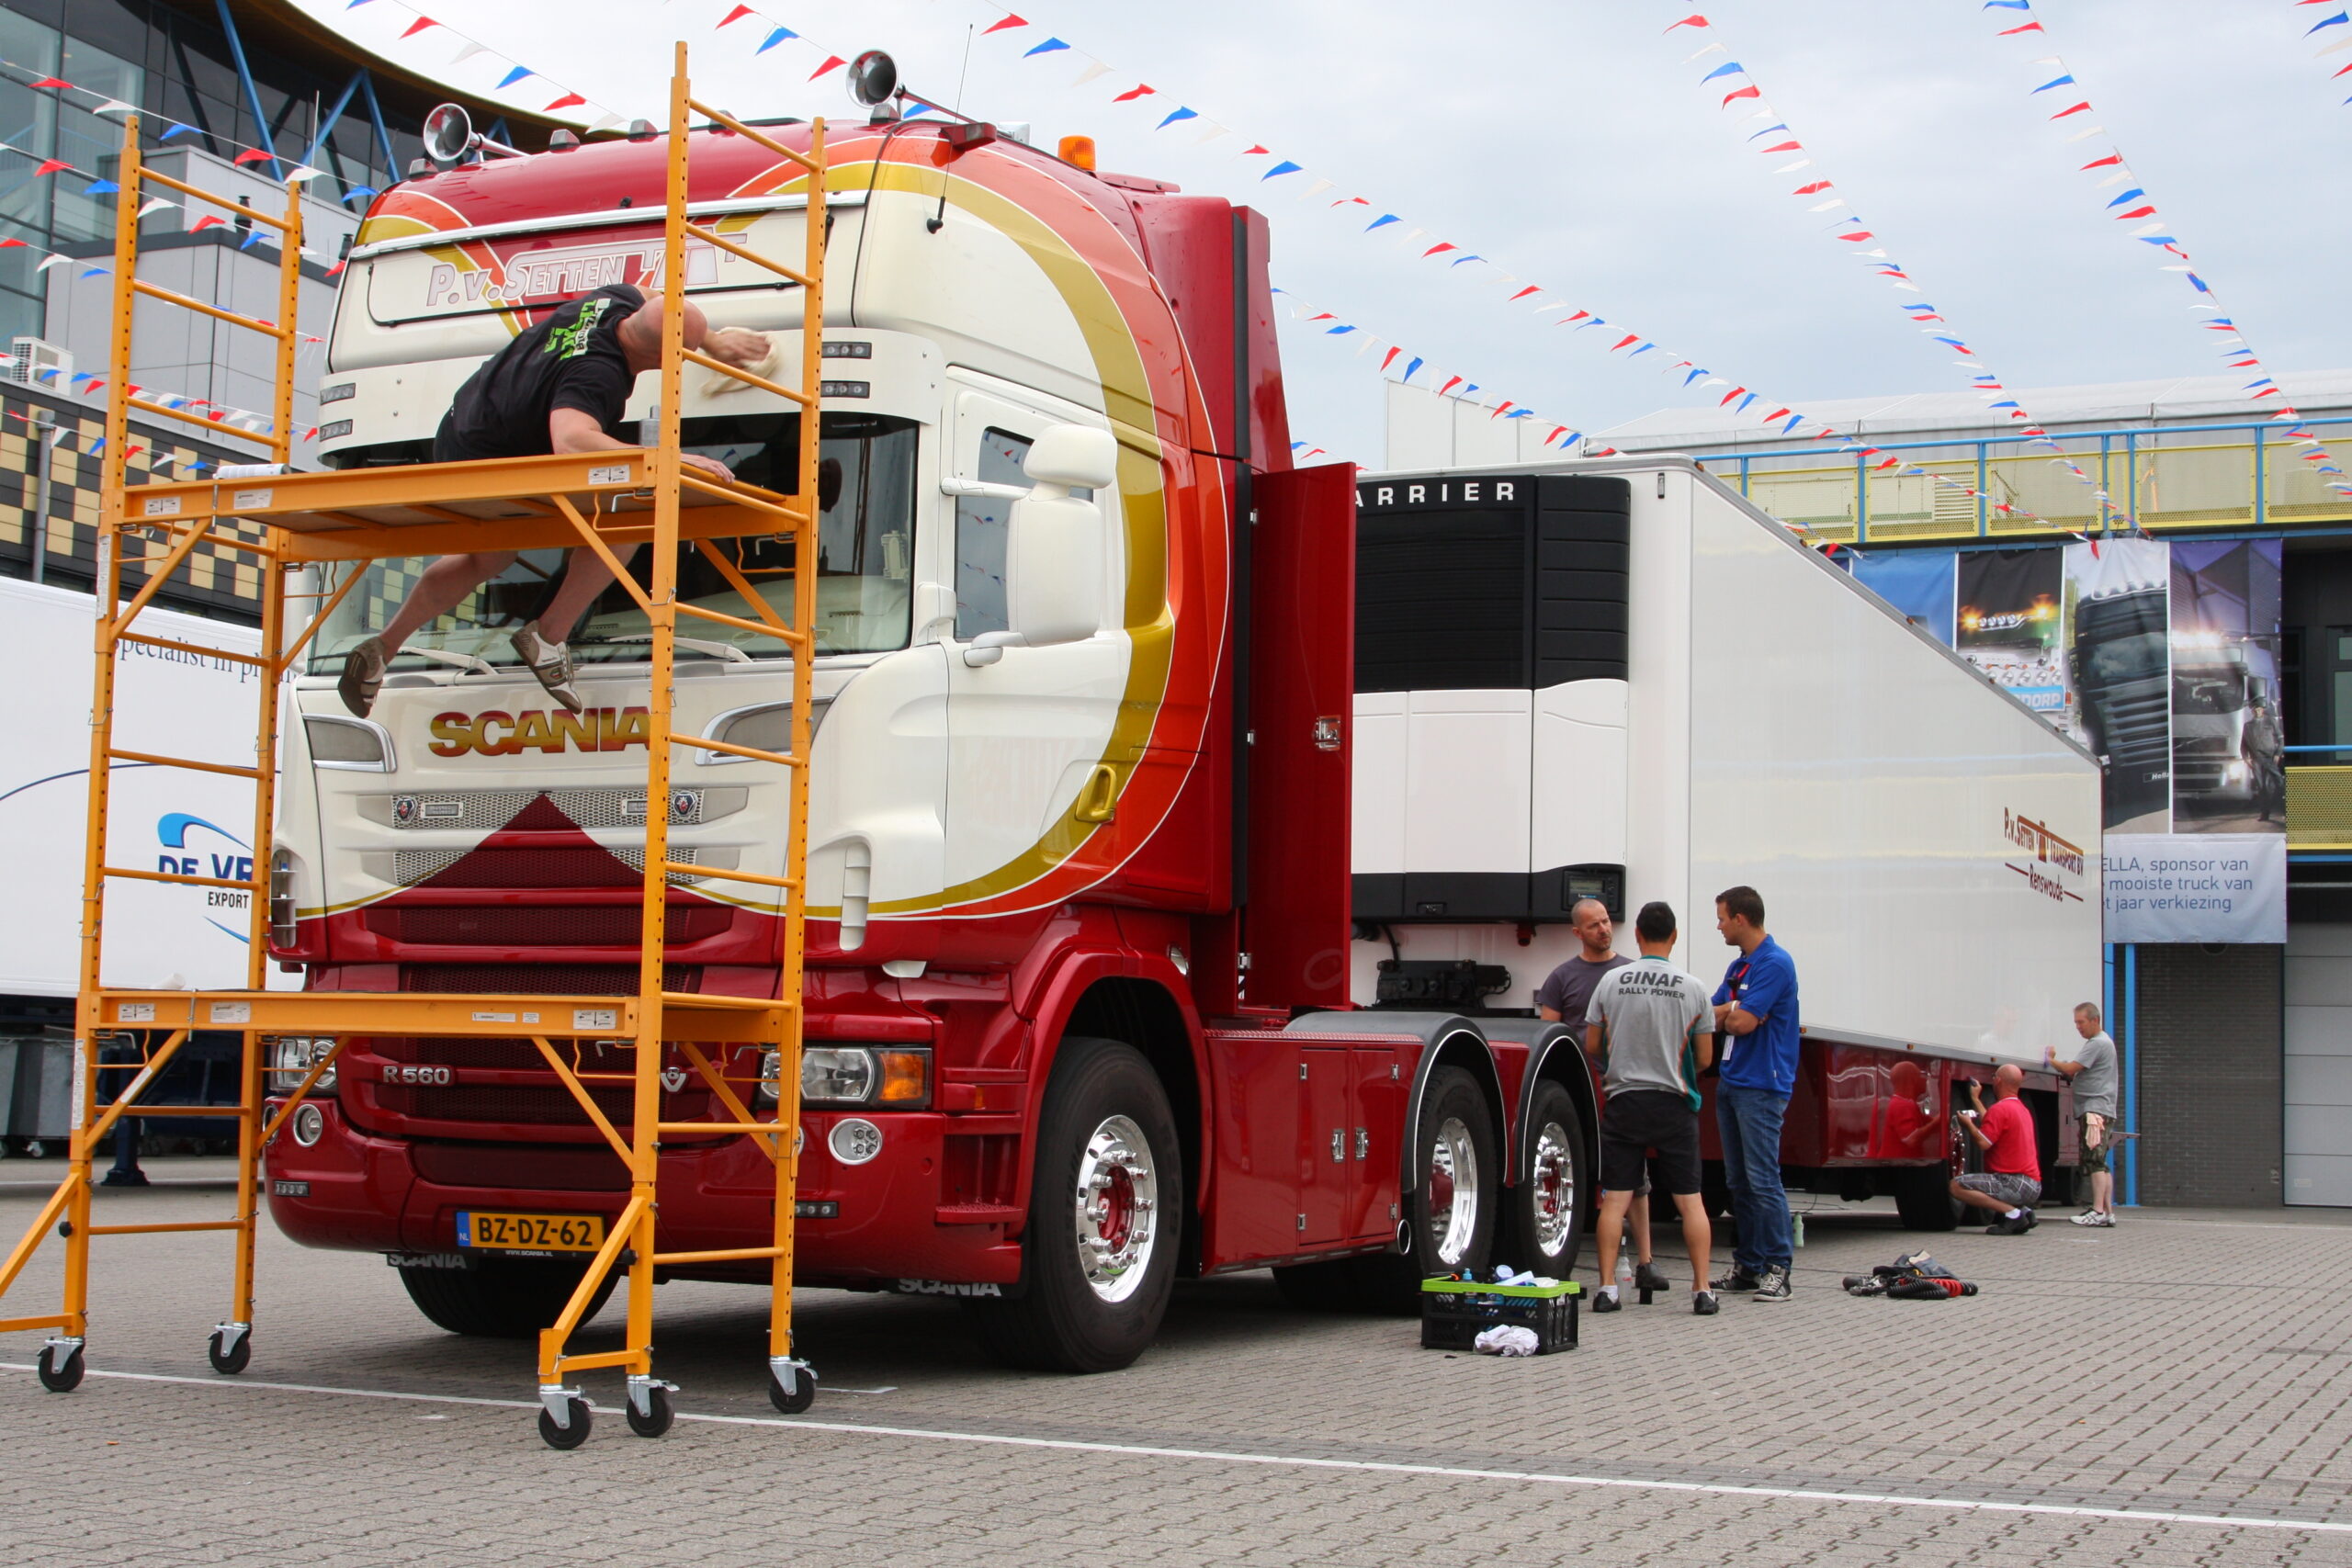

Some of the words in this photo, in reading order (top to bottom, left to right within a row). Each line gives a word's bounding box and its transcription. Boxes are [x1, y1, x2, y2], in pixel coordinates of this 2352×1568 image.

[428, 706, 651, 758] SCANIA
[158, 854, 199, 887] DE
[2150, 859, 2215, 874] sponsor
[2220, 860, 2248, 871] van
[2030, 863, 2064, 902] Renswoude
[2109, 875, 2173, 890] mooiste
[2177, 875, 2220, 890] truck
[2224, 878, 2253, 890] van
[208, 891, 249, 909] EXPORT
[2115, 896, 2144, 913] jaar
[2149, 895, 2232, 913] verkiezing
[1619, 971, 1684, 988] GINAF
[1618, 987, 1647, 996] RALLY
[1650, 988, 1685, 999] POWER
[382, 1066, 399, 1084] R
[401, 1066, 450, 1085] 560
[459, 1233, 469, 1241] NL
[478, 1217, 593, 1247] BZ-DZ-62
[389, 1253, 468, 1269] SCANIA
